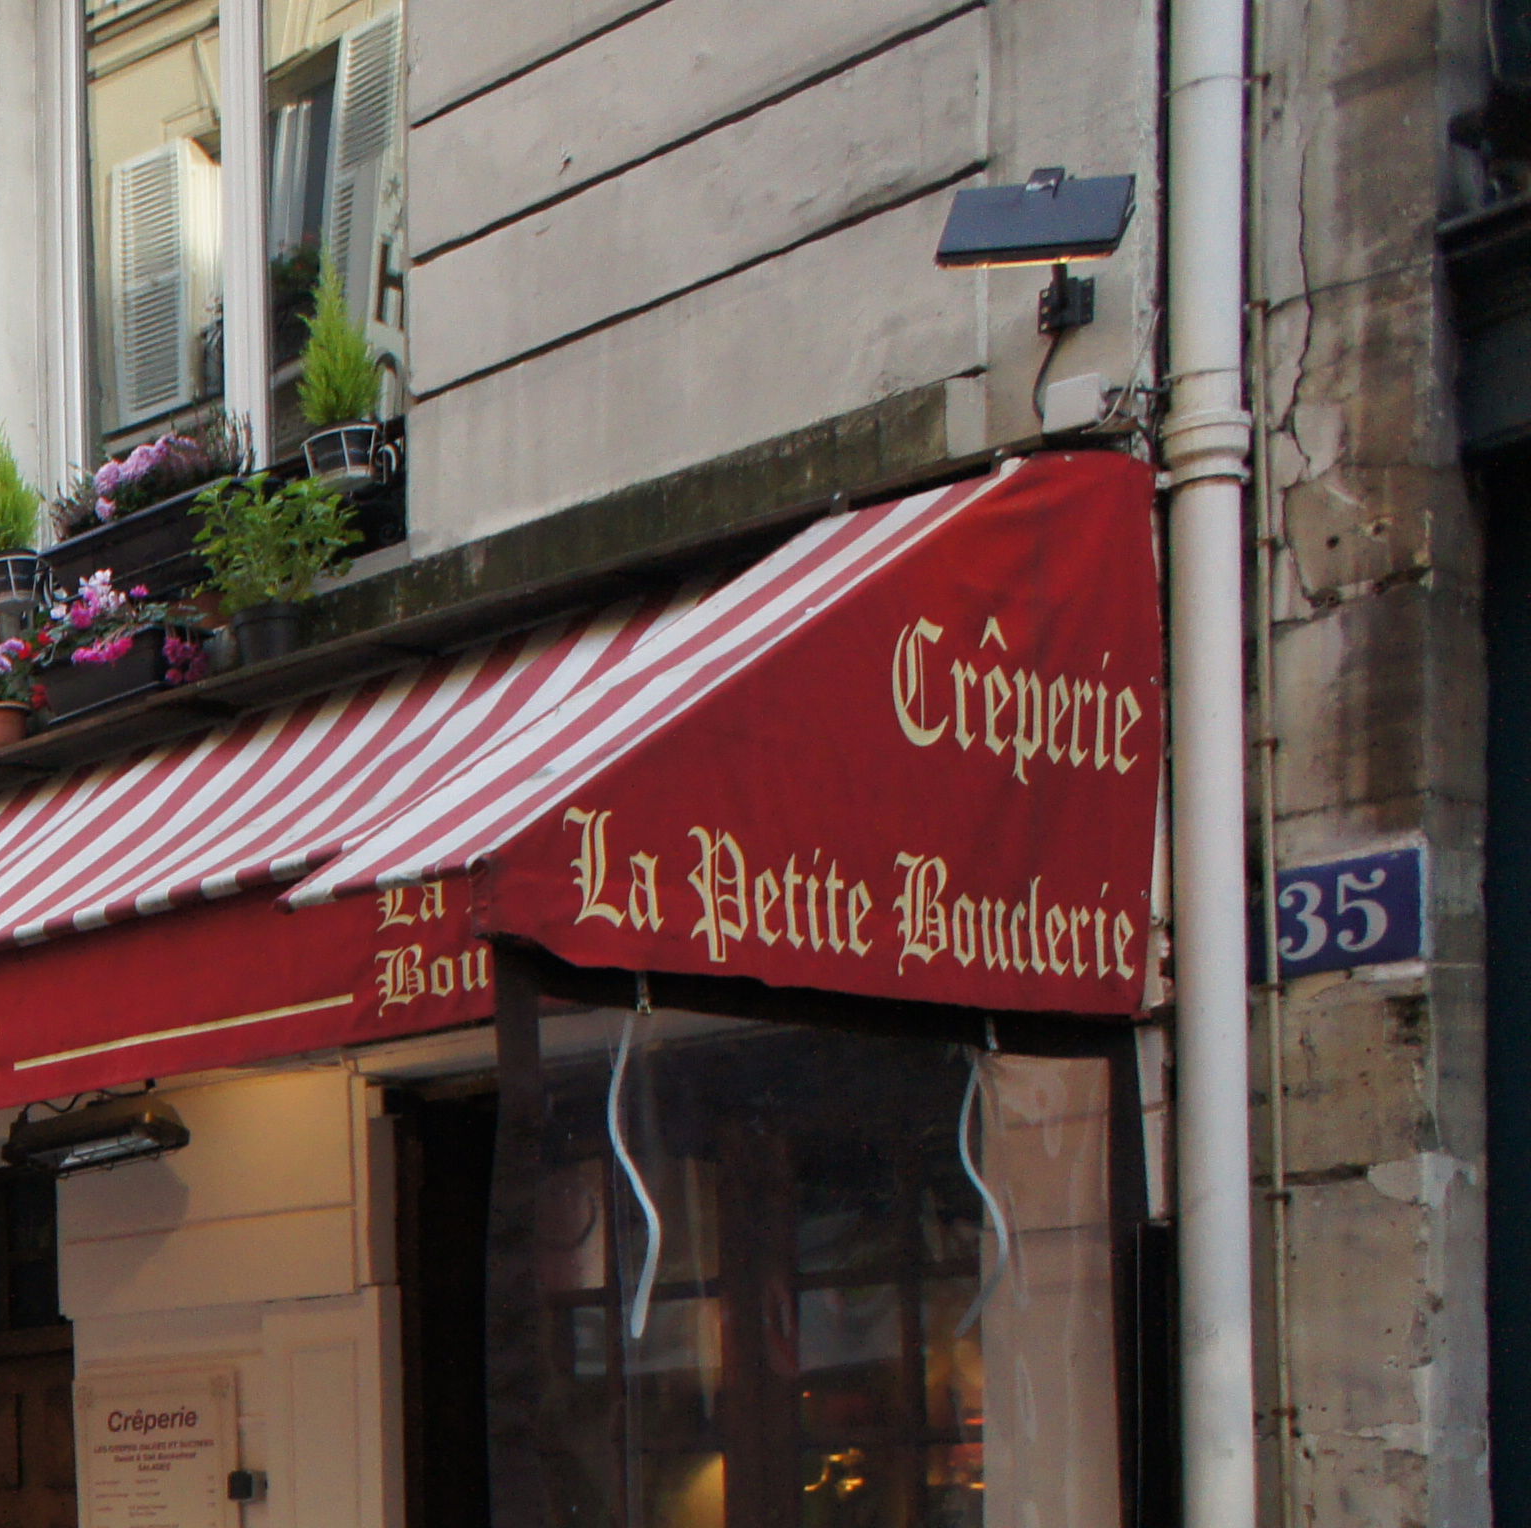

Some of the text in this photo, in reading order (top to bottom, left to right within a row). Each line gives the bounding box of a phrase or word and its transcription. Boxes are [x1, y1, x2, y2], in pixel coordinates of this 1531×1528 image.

[893, 617, 1141, 783] Crêperie
[563, 807, 1136, 979] La Petite Bouclerie
[1279, 868, 1388, 961] 35
[374, 943, 489, 1017] Bou
[108, 1406, 197, 1434] Crêperie
